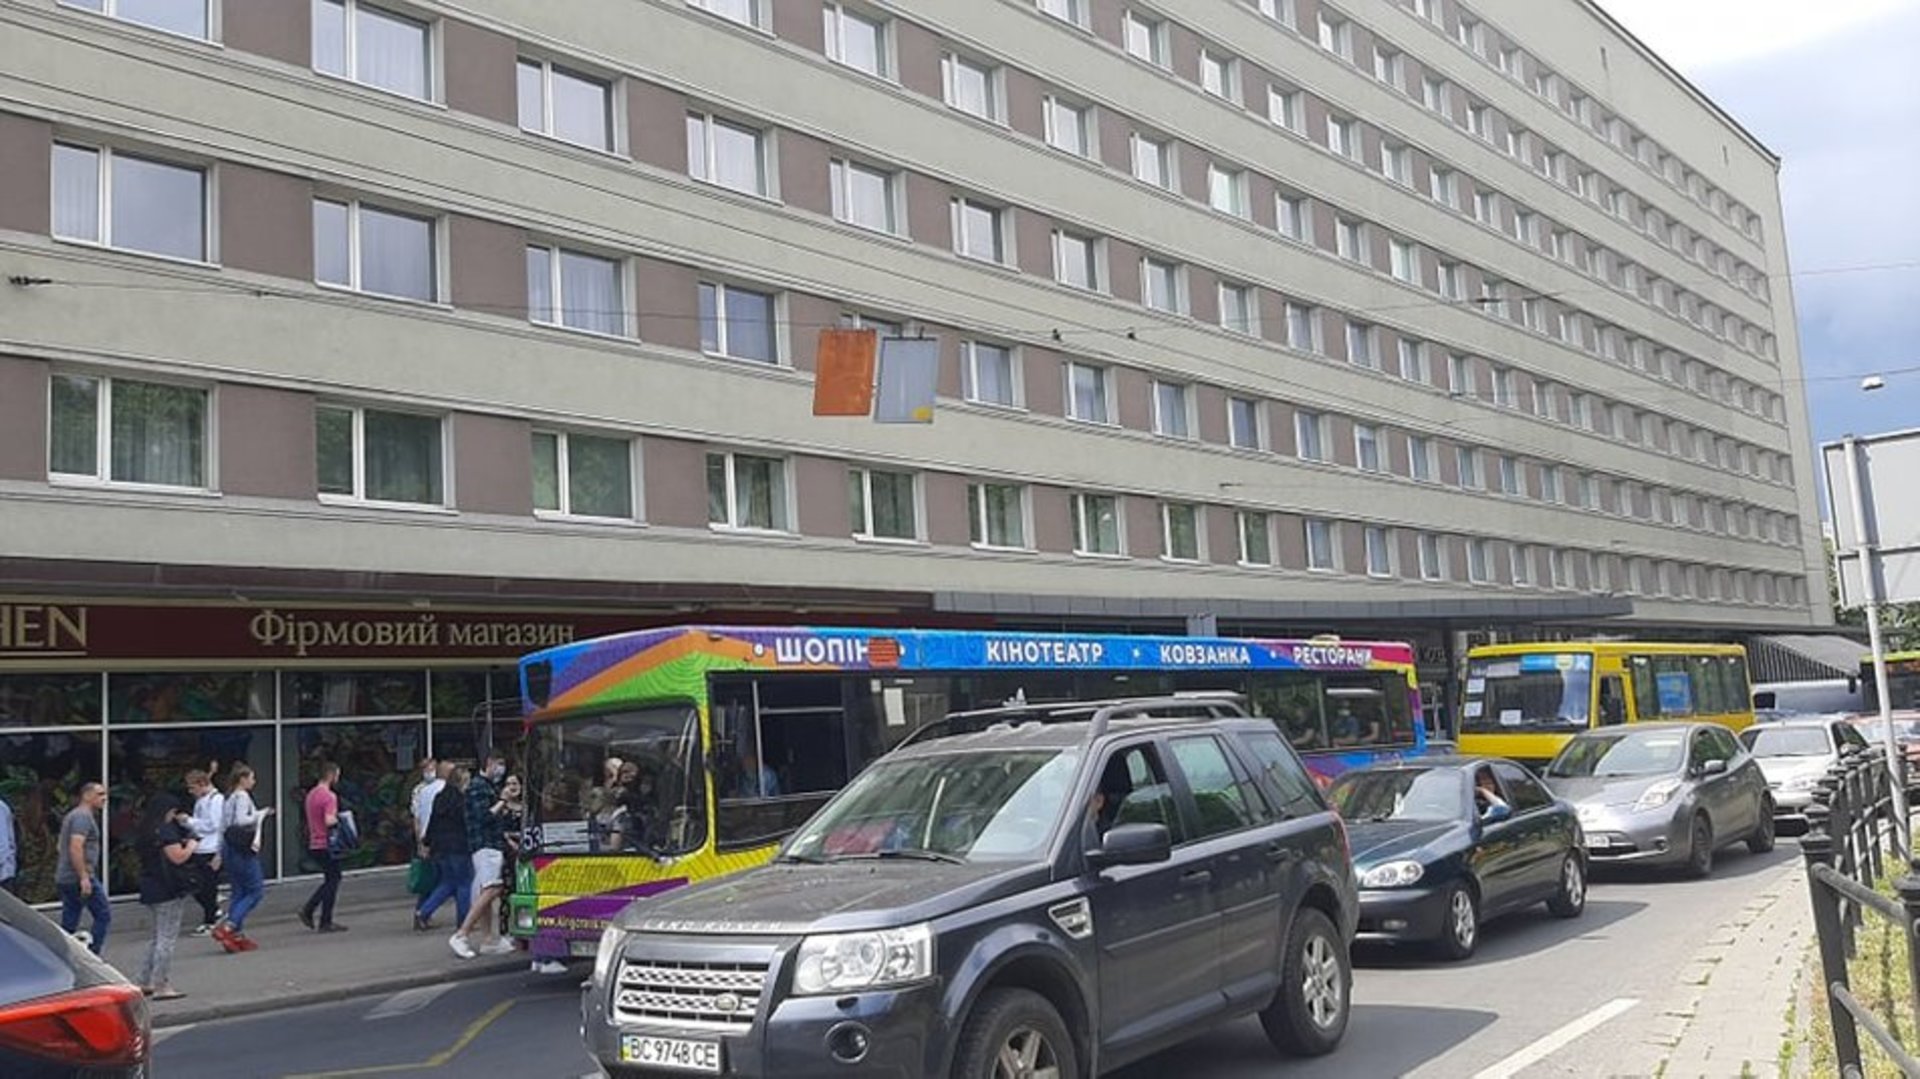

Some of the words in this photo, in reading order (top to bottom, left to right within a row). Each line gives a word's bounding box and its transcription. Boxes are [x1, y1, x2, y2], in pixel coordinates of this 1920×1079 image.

[250, 609, 438, 656] Фірмовий
[449, 623, 575, 646] магазин
[775, 637, 873, 663] ШОПІН
[986, 640, 1103, 664] КІНОТЕАТР
[1159, 645, 1251, 665] КОВЗАНКА
[1292, 646, 1373, 665] РЕСТОРАНИ
[631, 1037, 652, 1061] BC
[654, 1040, 691, 1064] 9748
[693, 1043, 717, 1068] CE
